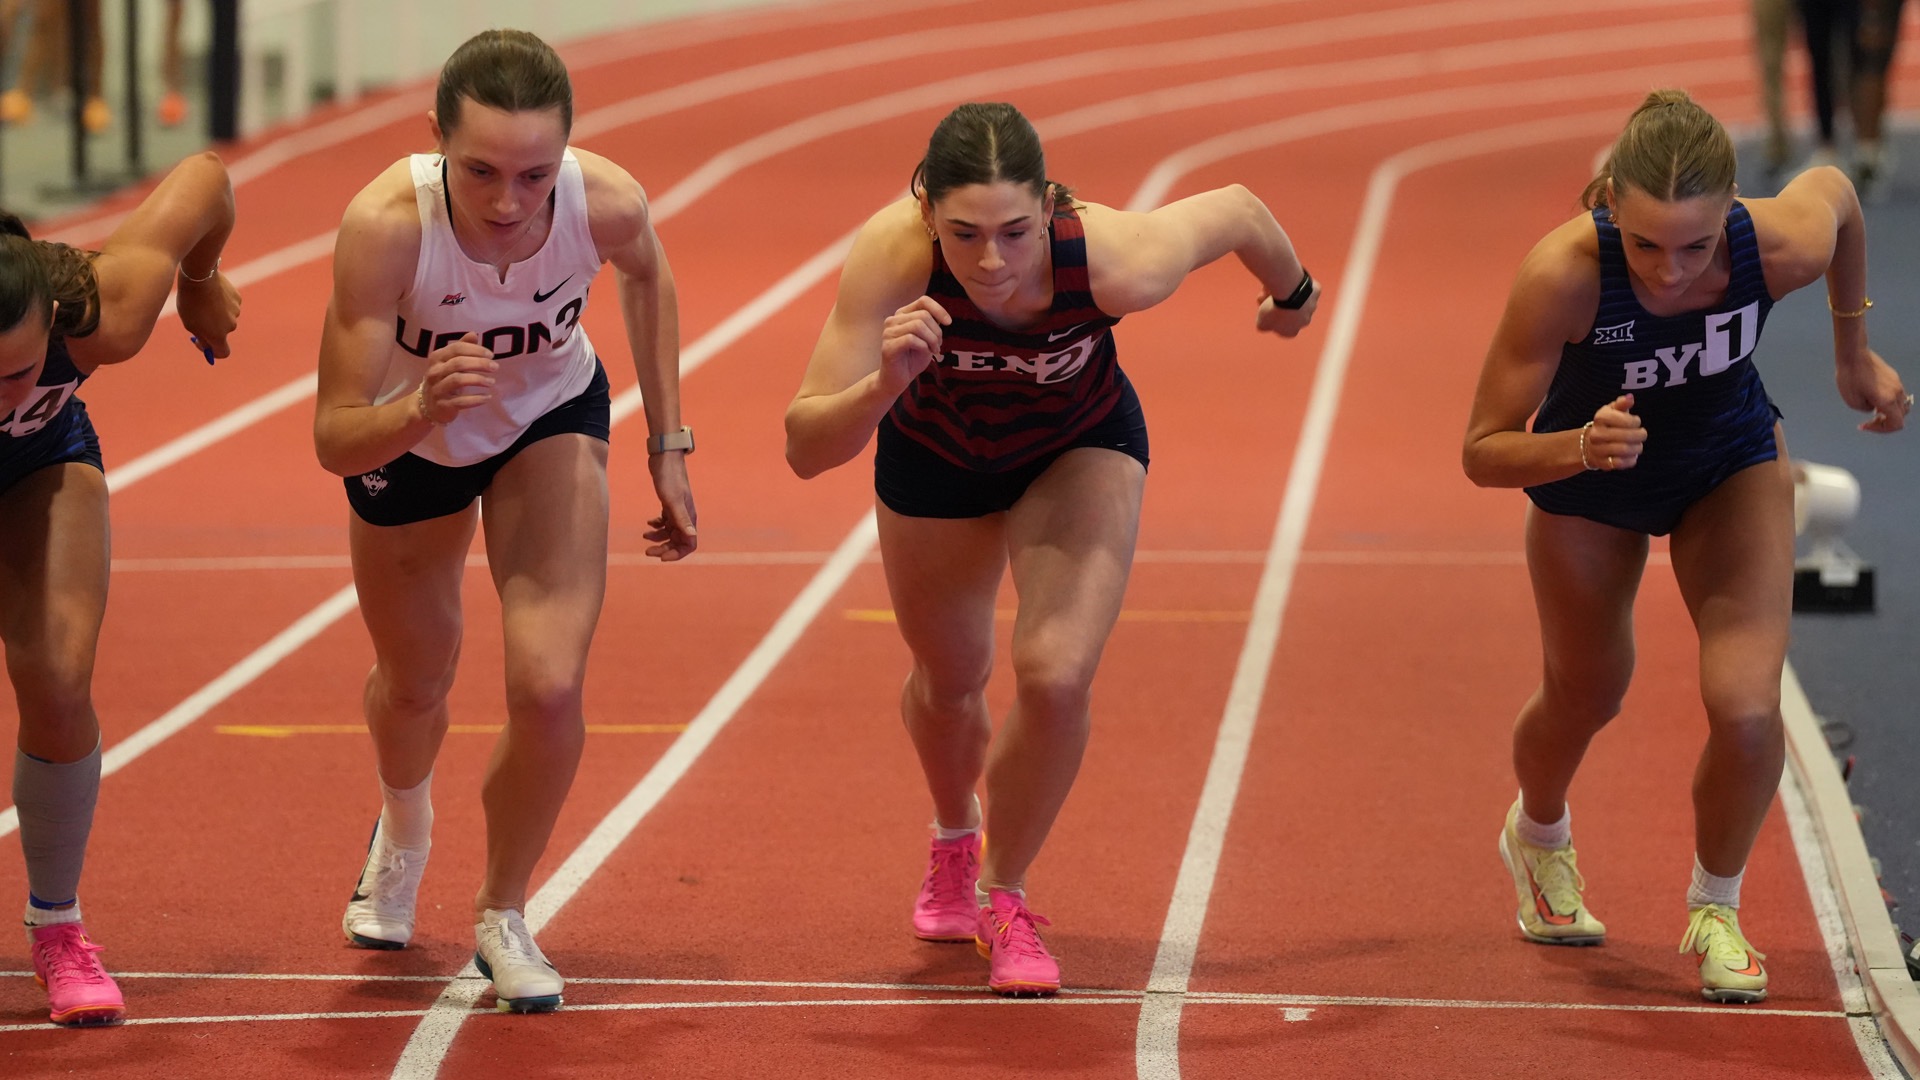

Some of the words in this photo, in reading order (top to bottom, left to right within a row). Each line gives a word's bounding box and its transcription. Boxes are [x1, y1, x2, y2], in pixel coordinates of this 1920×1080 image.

[552, 297, 583, 349] 3
[1716, 312, 1742, 362] 1
[931, 350, 1038, 374] EN
[1044, 346, 1084, 381] 2
[1621, 342, 1731, 391] BY
[19, 387, 65, 423] 4
